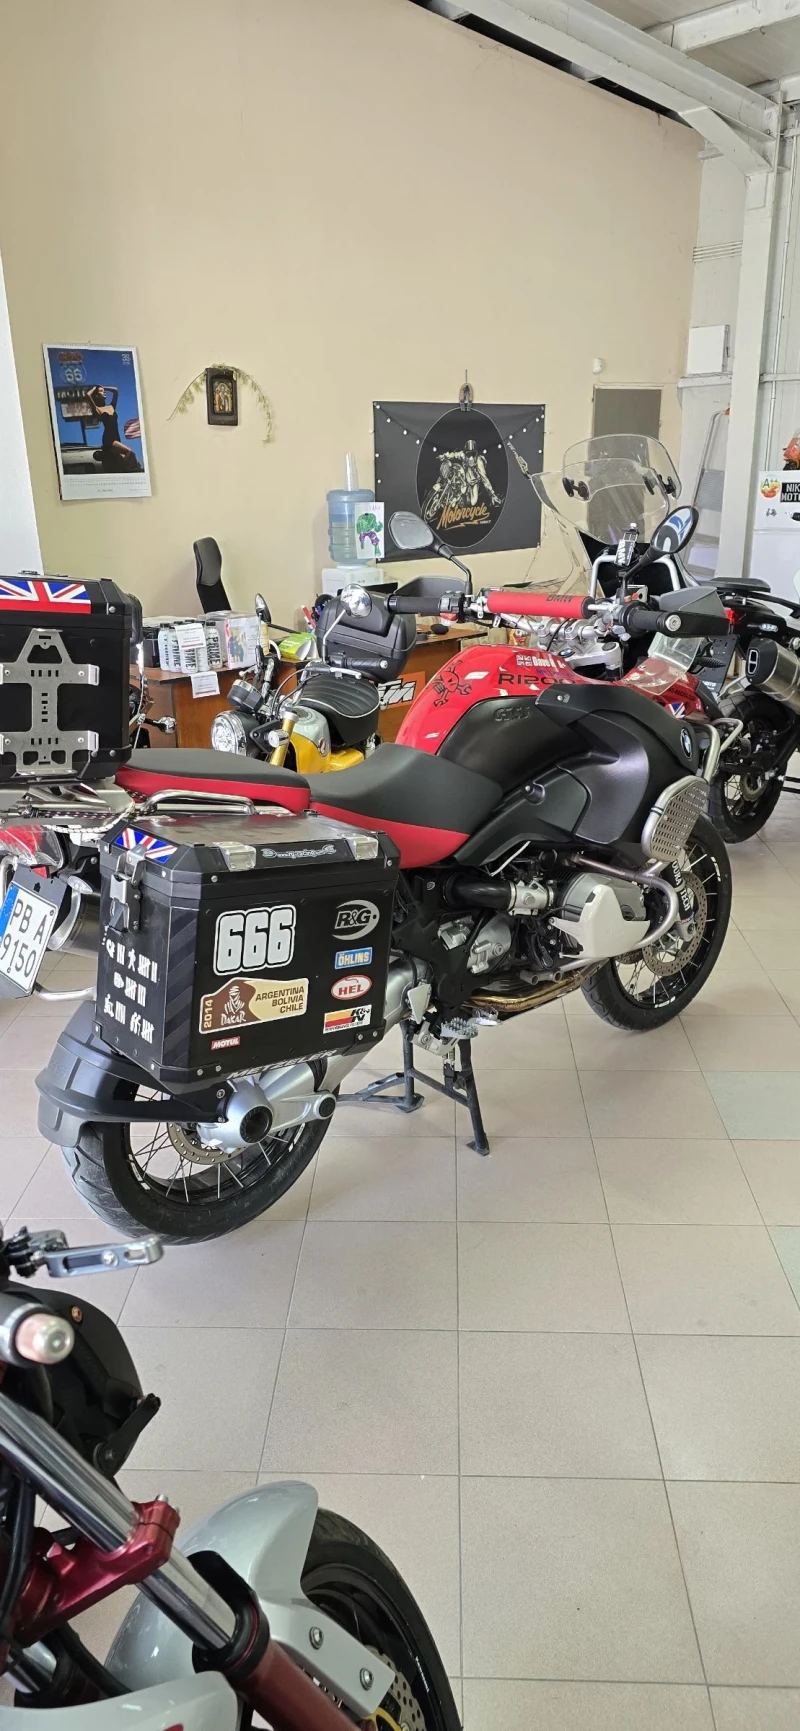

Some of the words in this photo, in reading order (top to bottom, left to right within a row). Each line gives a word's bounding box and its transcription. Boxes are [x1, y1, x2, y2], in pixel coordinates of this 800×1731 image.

[65, 368, 83, 382] 66
[436, 502, 490, 530] Motorcycle
[546, 594, 575, 603] BMW
[10, 899, 33, 933] PB
[33, 914, 48, 944] A
[334, 908, 372, 930] R&G
[214, 905, 296, 975] 666
[0, 934, 37, 978] 9150
[338, 951, 370, 966] ÖHLINS
[255, 986, 305, 1002] ARGENTINA
[338, 984, 364, 996] HEL
[271, 994, 304, 1007] BOLIVIA
[280, 1002, 304, 1014] CHILE
[203, 999, 214, 1028] 2014
[212, 1037, 240, 1049] MOTUL
